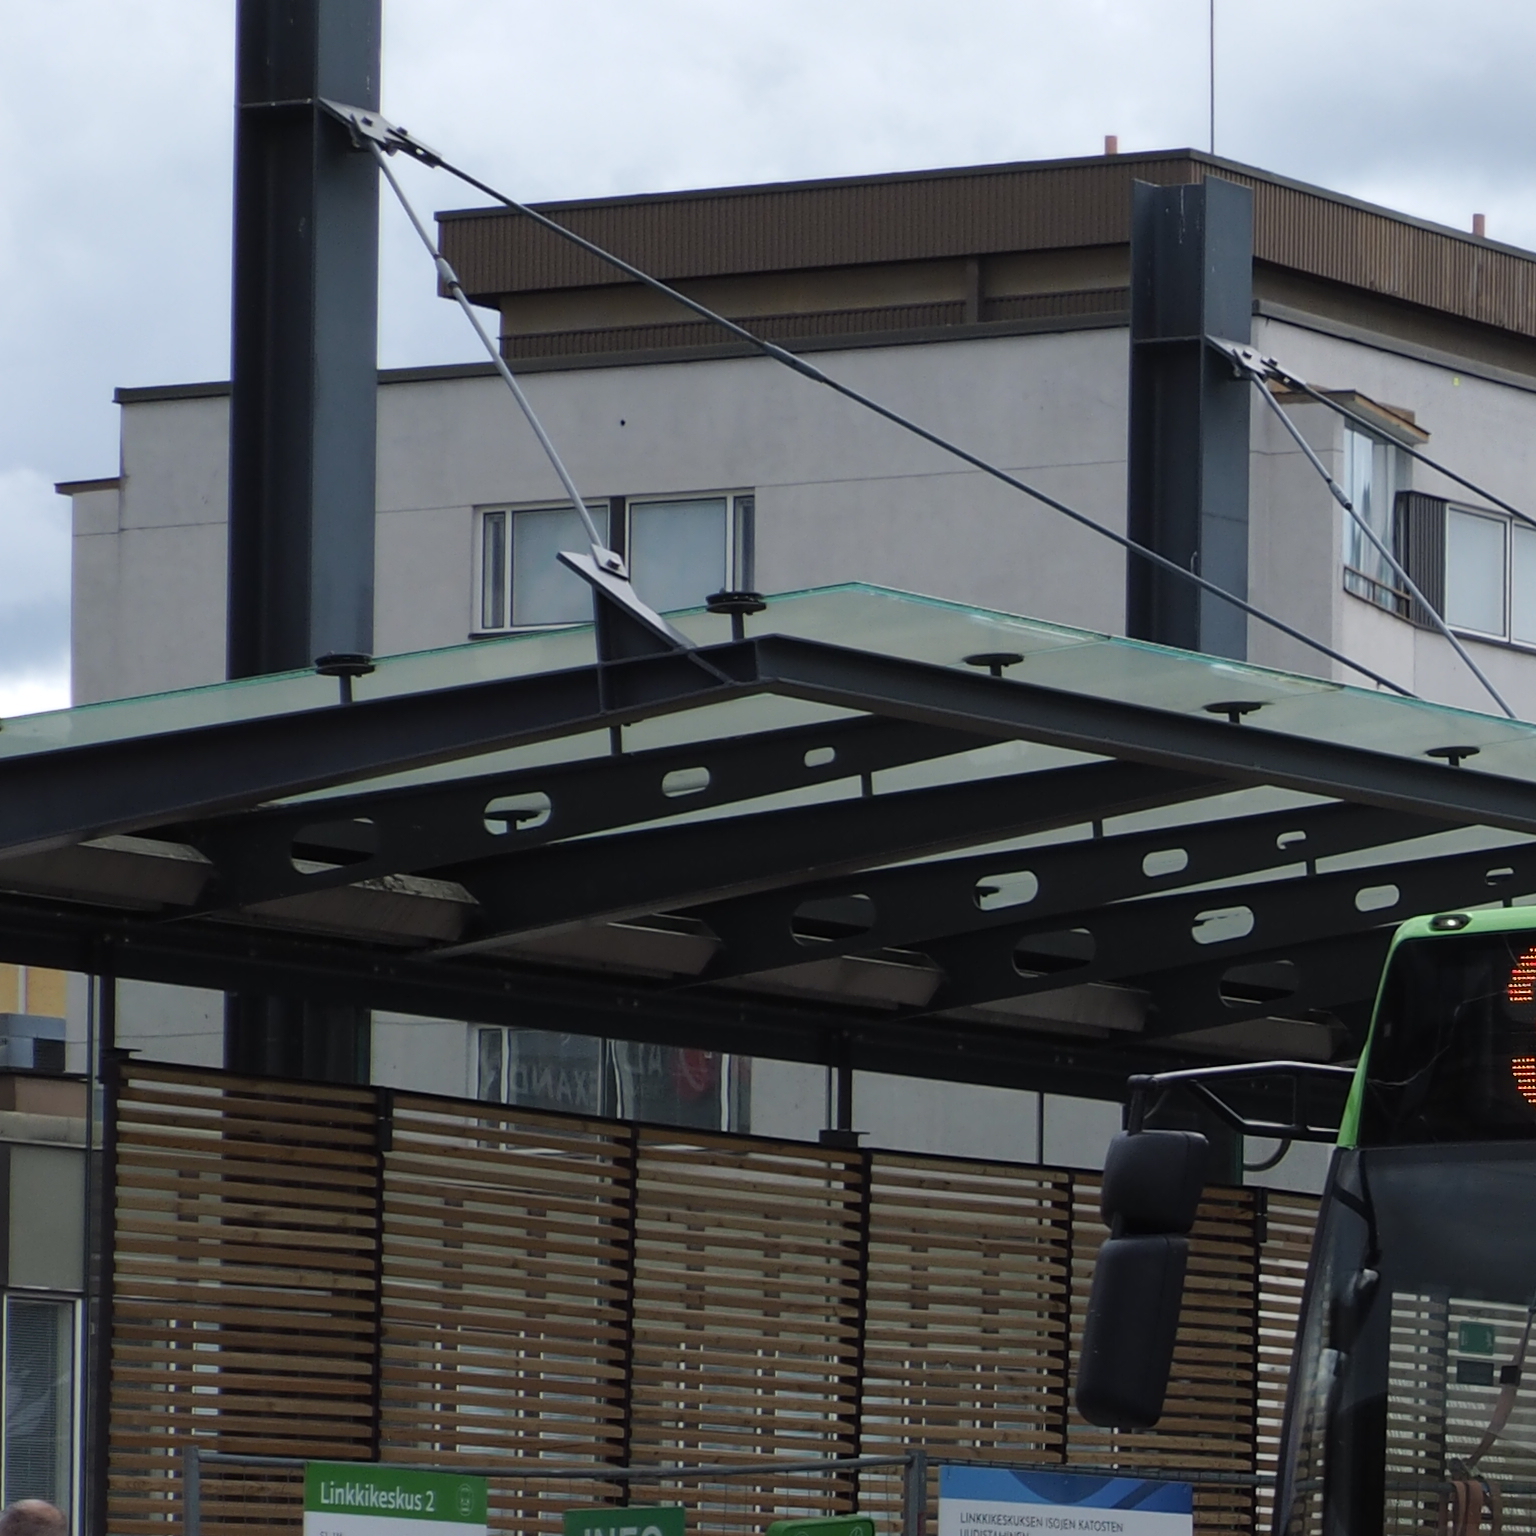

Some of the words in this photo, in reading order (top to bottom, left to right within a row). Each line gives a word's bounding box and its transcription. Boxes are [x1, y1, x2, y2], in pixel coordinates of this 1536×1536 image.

[321, 1481, 422, 1511] Linkkikeskus
[425, 1491, 436, 1512] 2
[960, 1512, 1043, 1528] LINKKIKESKUKSEN
[1045, 1519, 1075, 1531] ISOJEN
[1078, 1520, 1124, 1532] KATOSTEN
